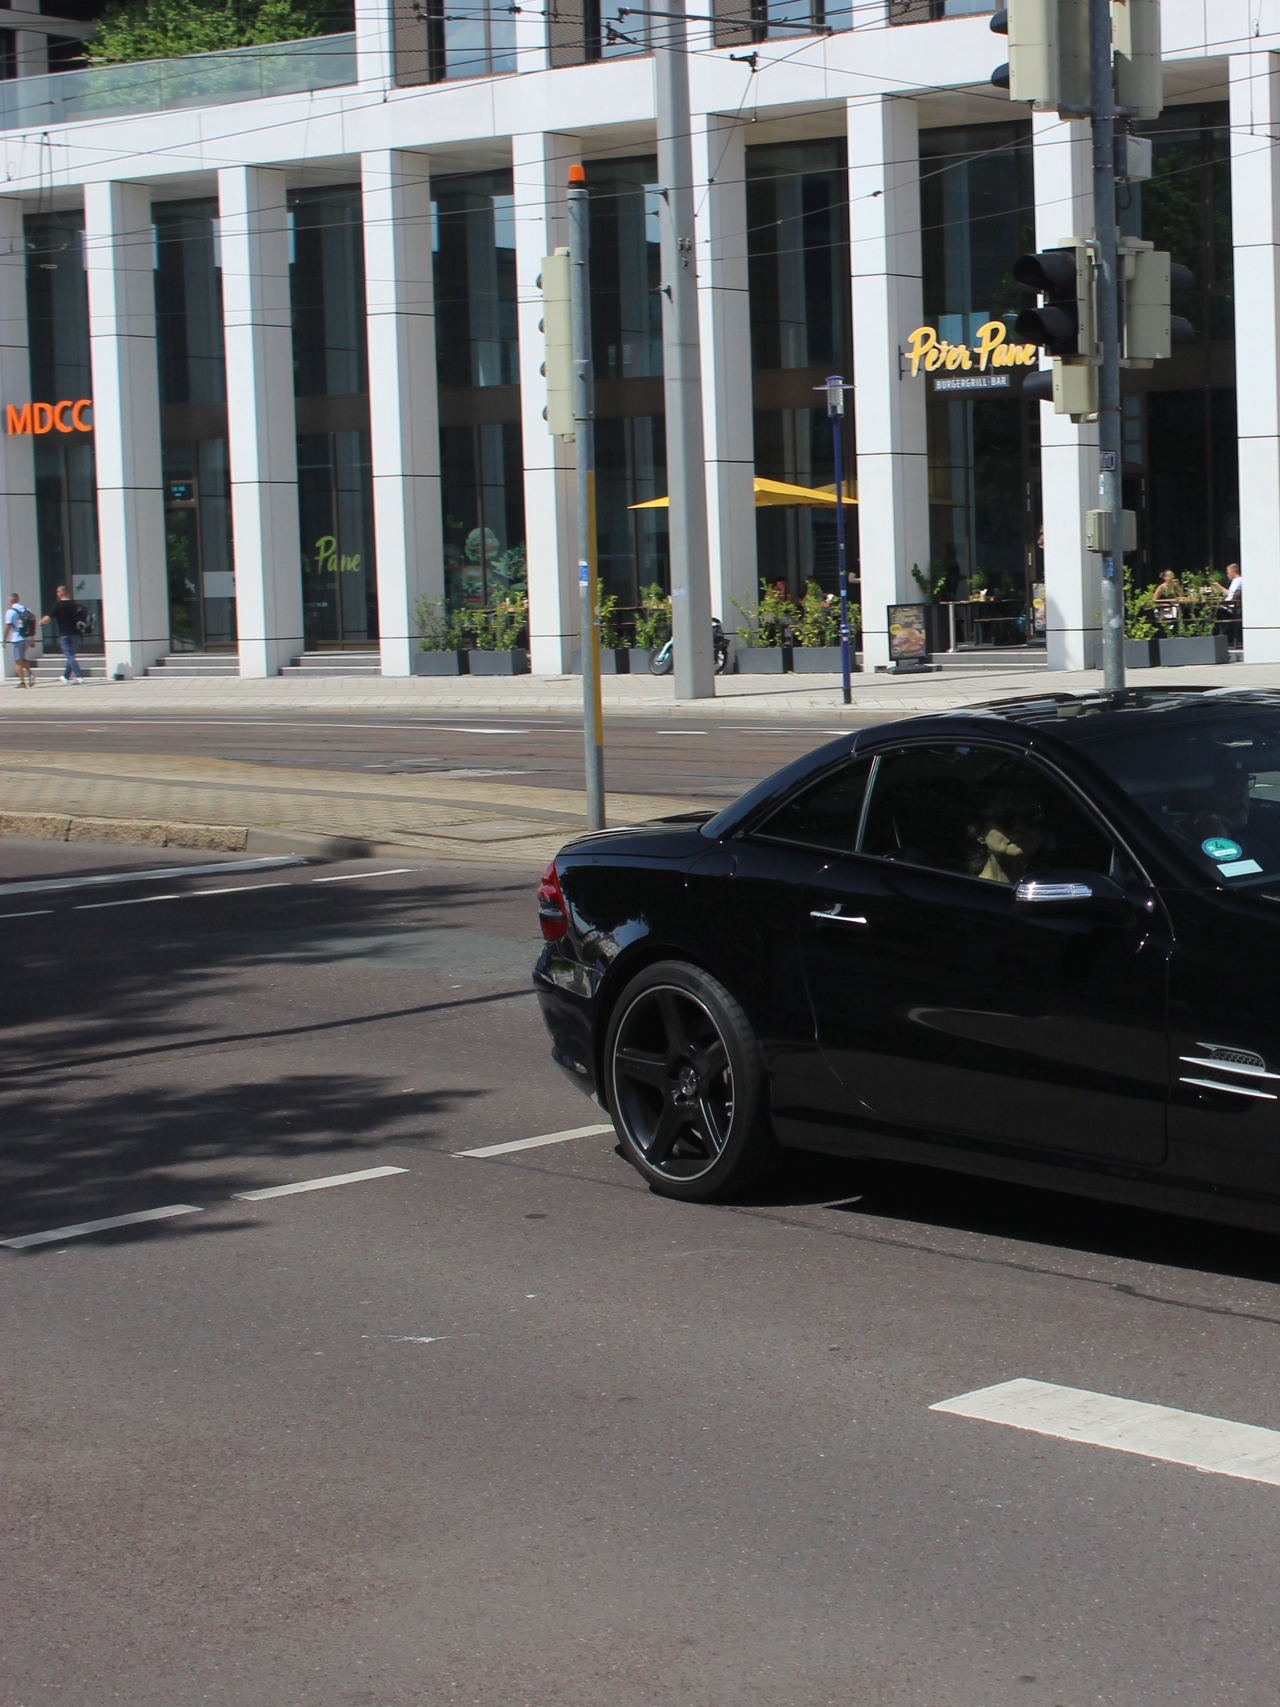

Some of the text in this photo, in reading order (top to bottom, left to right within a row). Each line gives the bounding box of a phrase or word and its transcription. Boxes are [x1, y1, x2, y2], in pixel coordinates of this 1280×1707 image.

[904, 321, 1037, 377] Peter Pane
[6, 399, 93, 436] MDCC
[314, 535, 361, 574] Pane
